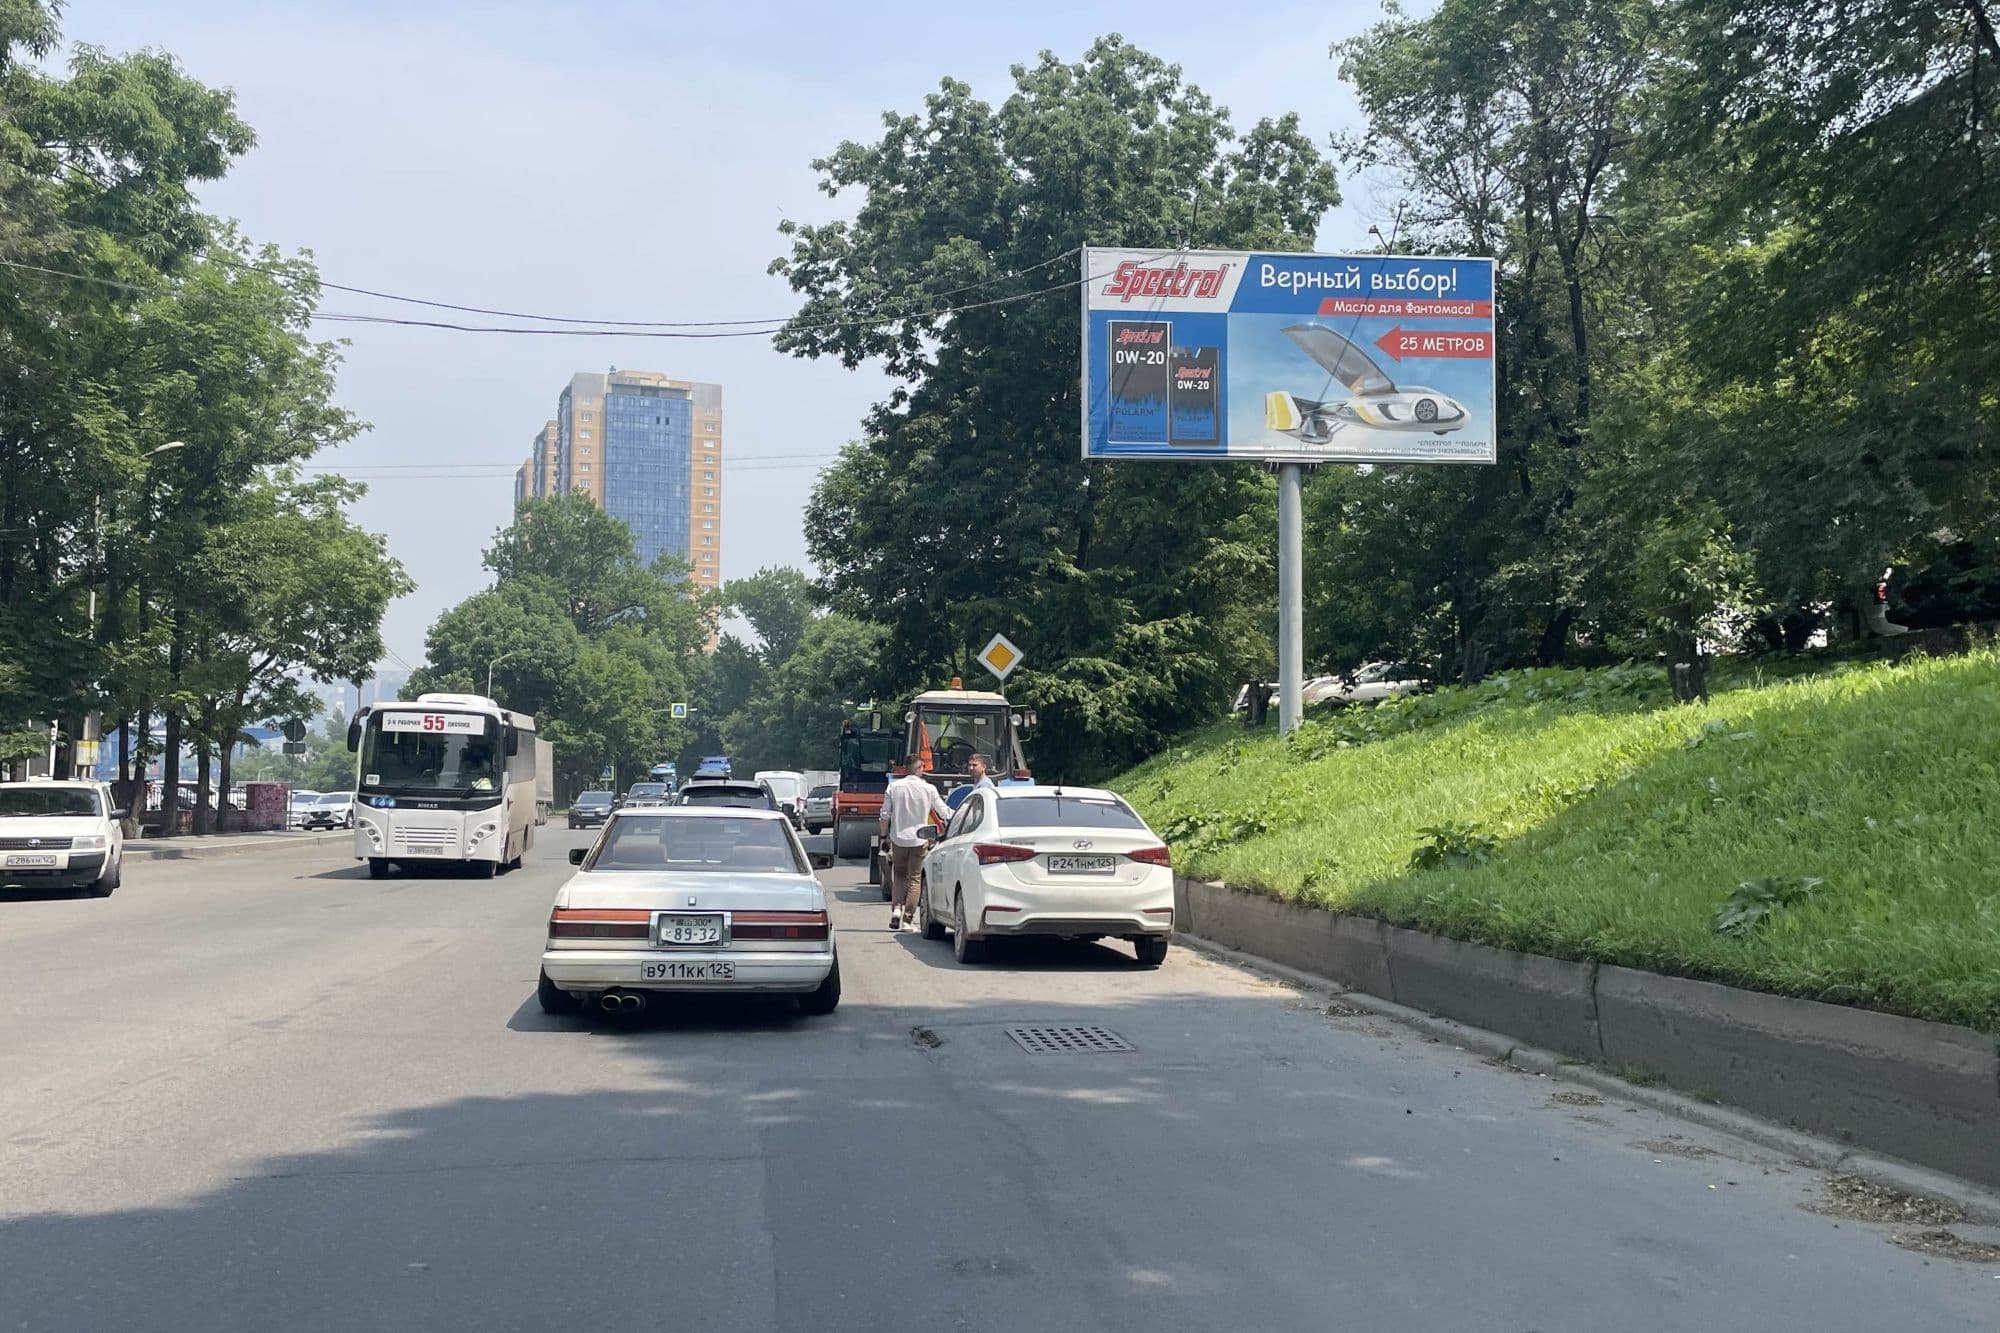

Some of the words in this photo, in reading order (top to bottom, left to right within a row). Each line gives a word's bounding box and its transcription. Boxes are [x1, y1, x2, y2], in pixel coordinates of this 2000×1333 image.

[1260, 264, 1361, 295] Верный
[1371, 267, 1458, 298] выбор!
[1334, 300, 1376, 314] Масло
[1379, 304, 1402, 314] для
[1405, 301, 1475, 316] Фантомаса!
[1400, 337, 1418, 351] 25
[1422, 337, 1485, 352] МЕТРОВ
[1115, 350, 1165, 365] 0W-20
[1177, 380, 1210, 390] 0W-20
[423, 715, 446, 731] 55
[674, 927, 717, 941] 89-32
[708, 963, 732, 975] 125
